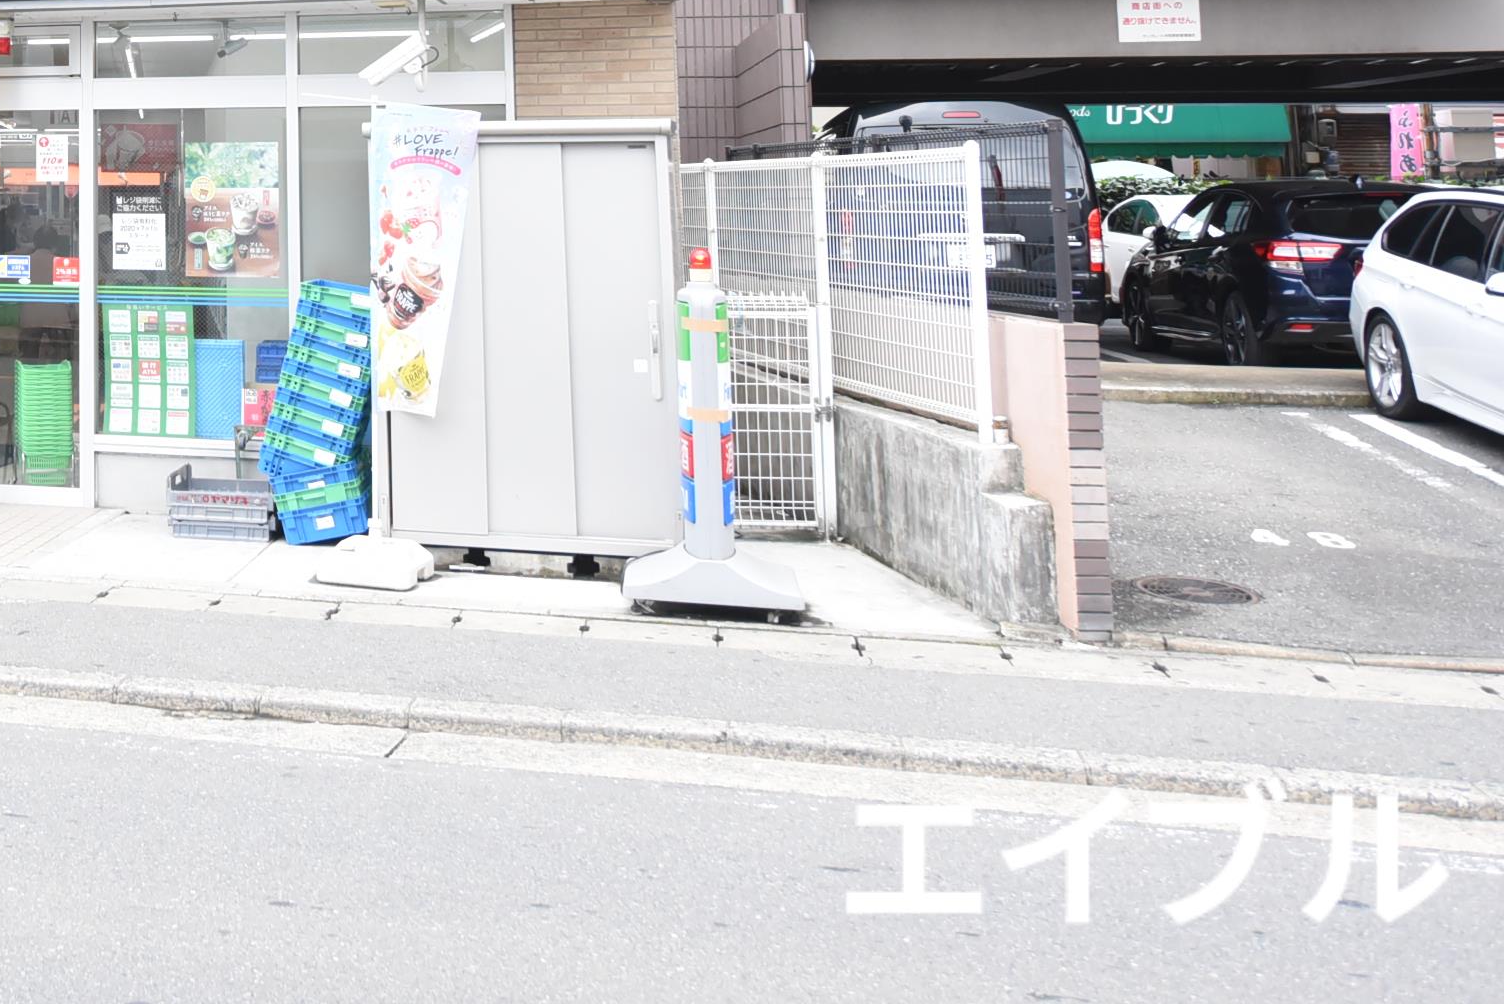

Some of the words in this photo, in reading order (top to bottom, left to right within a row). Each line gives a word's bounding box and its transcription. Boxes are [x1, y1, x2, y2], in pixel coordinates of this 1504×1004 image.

[1130, 1, 1184, 11] 商店街への
[393, 134, 445, 148] #LOVE
